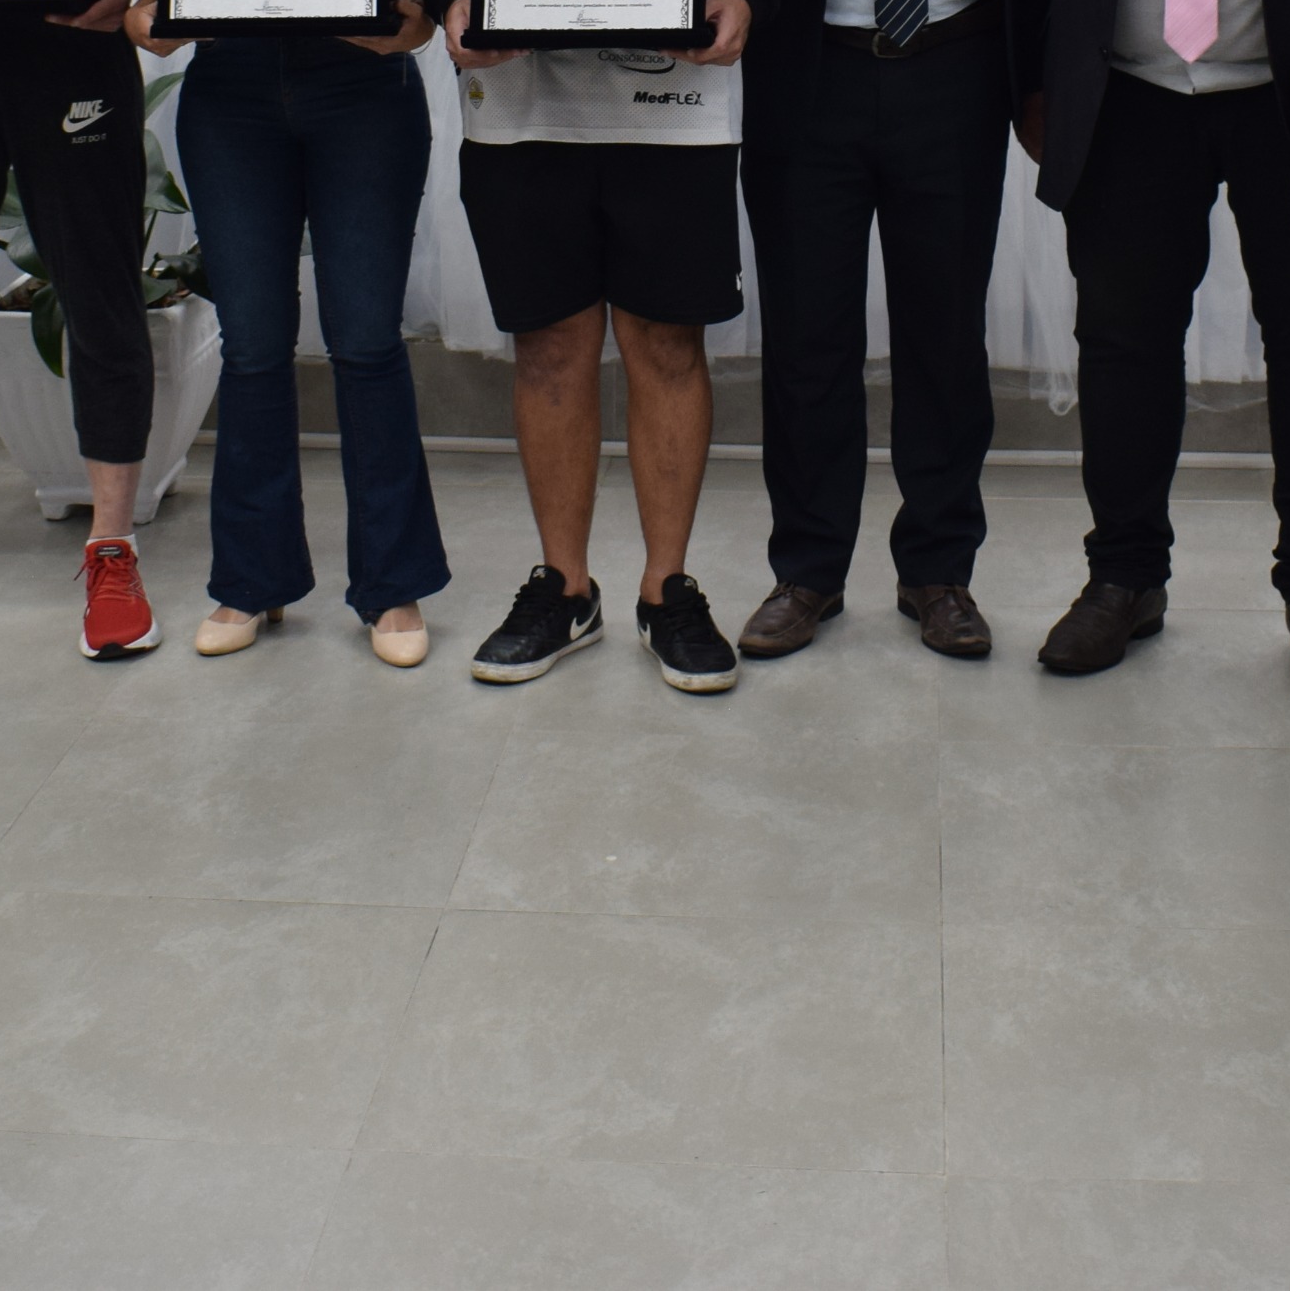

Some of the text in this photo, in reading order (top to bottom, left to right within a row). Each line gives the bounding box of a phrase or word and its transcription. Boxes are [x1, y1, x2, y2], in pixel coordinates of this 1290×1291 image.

[633, 91, 705, 106] MedFLEX
[69, 99, 103, 119] NIKE
[71, 136, 87, 144] JUST
[88, 134, 100, 142] DO
